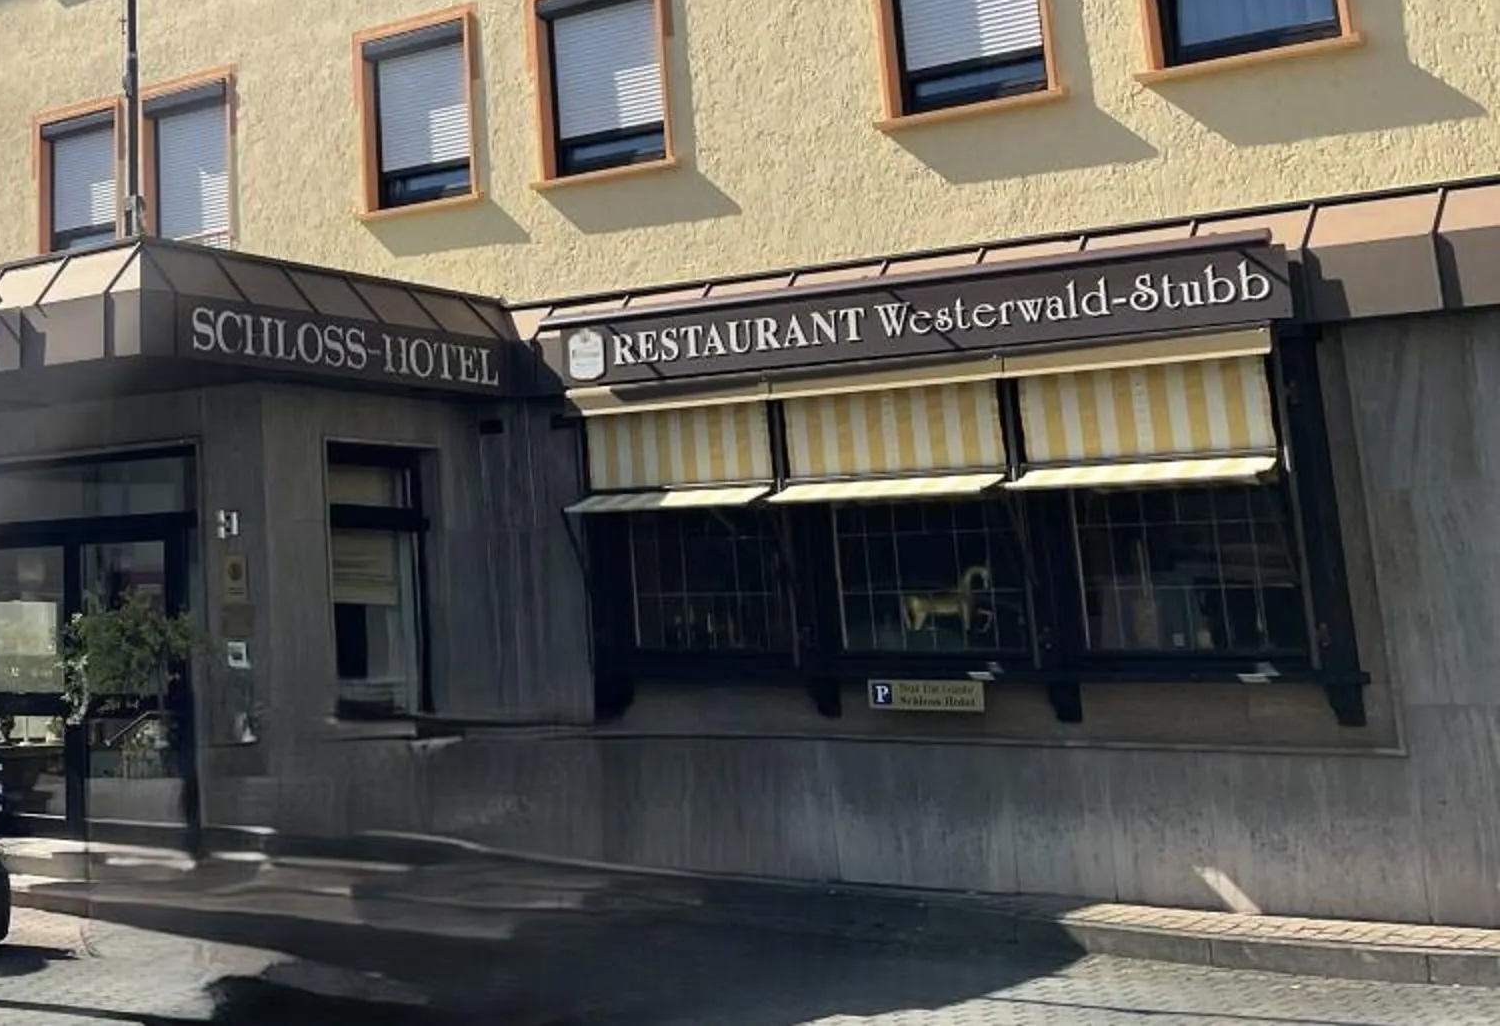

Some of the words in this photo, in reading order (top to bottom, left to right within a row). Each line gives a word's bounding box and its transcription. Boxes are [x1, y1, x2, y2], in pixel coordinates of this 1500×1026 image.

[192, 307, 499, 387] SCHLOSS-HOTEL
[612, 307, 865, 366] RESTAURANT
[874, 260, 1272, 338] Westerwald-Stubb
[874, 685, 889, 703] P
